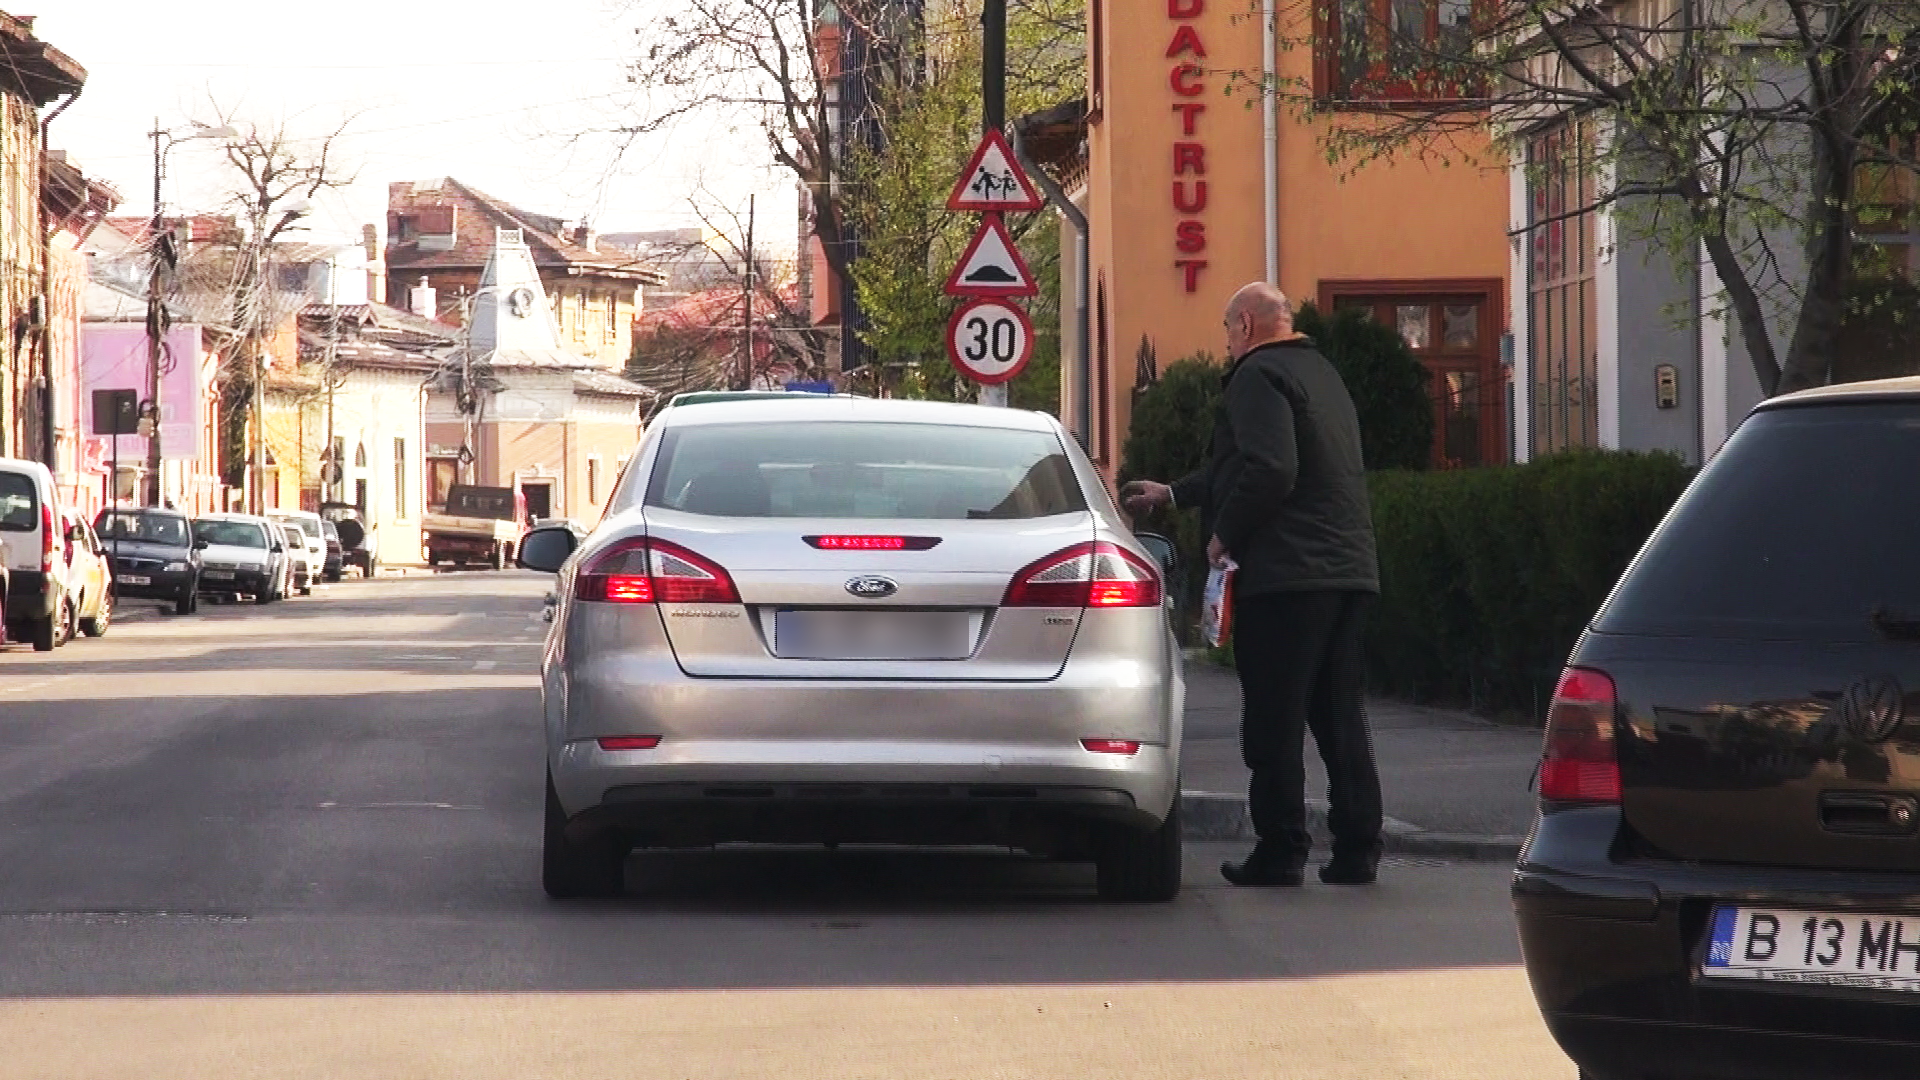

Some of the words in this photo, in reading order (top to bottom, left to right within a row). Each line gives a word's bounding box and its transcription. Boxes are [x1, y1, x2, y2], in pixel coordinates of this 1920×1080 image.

[965, 317, 1016, 363] 30
[1744, 913, 1780, 961] B
[1803, 917, 1845, 967] 13
